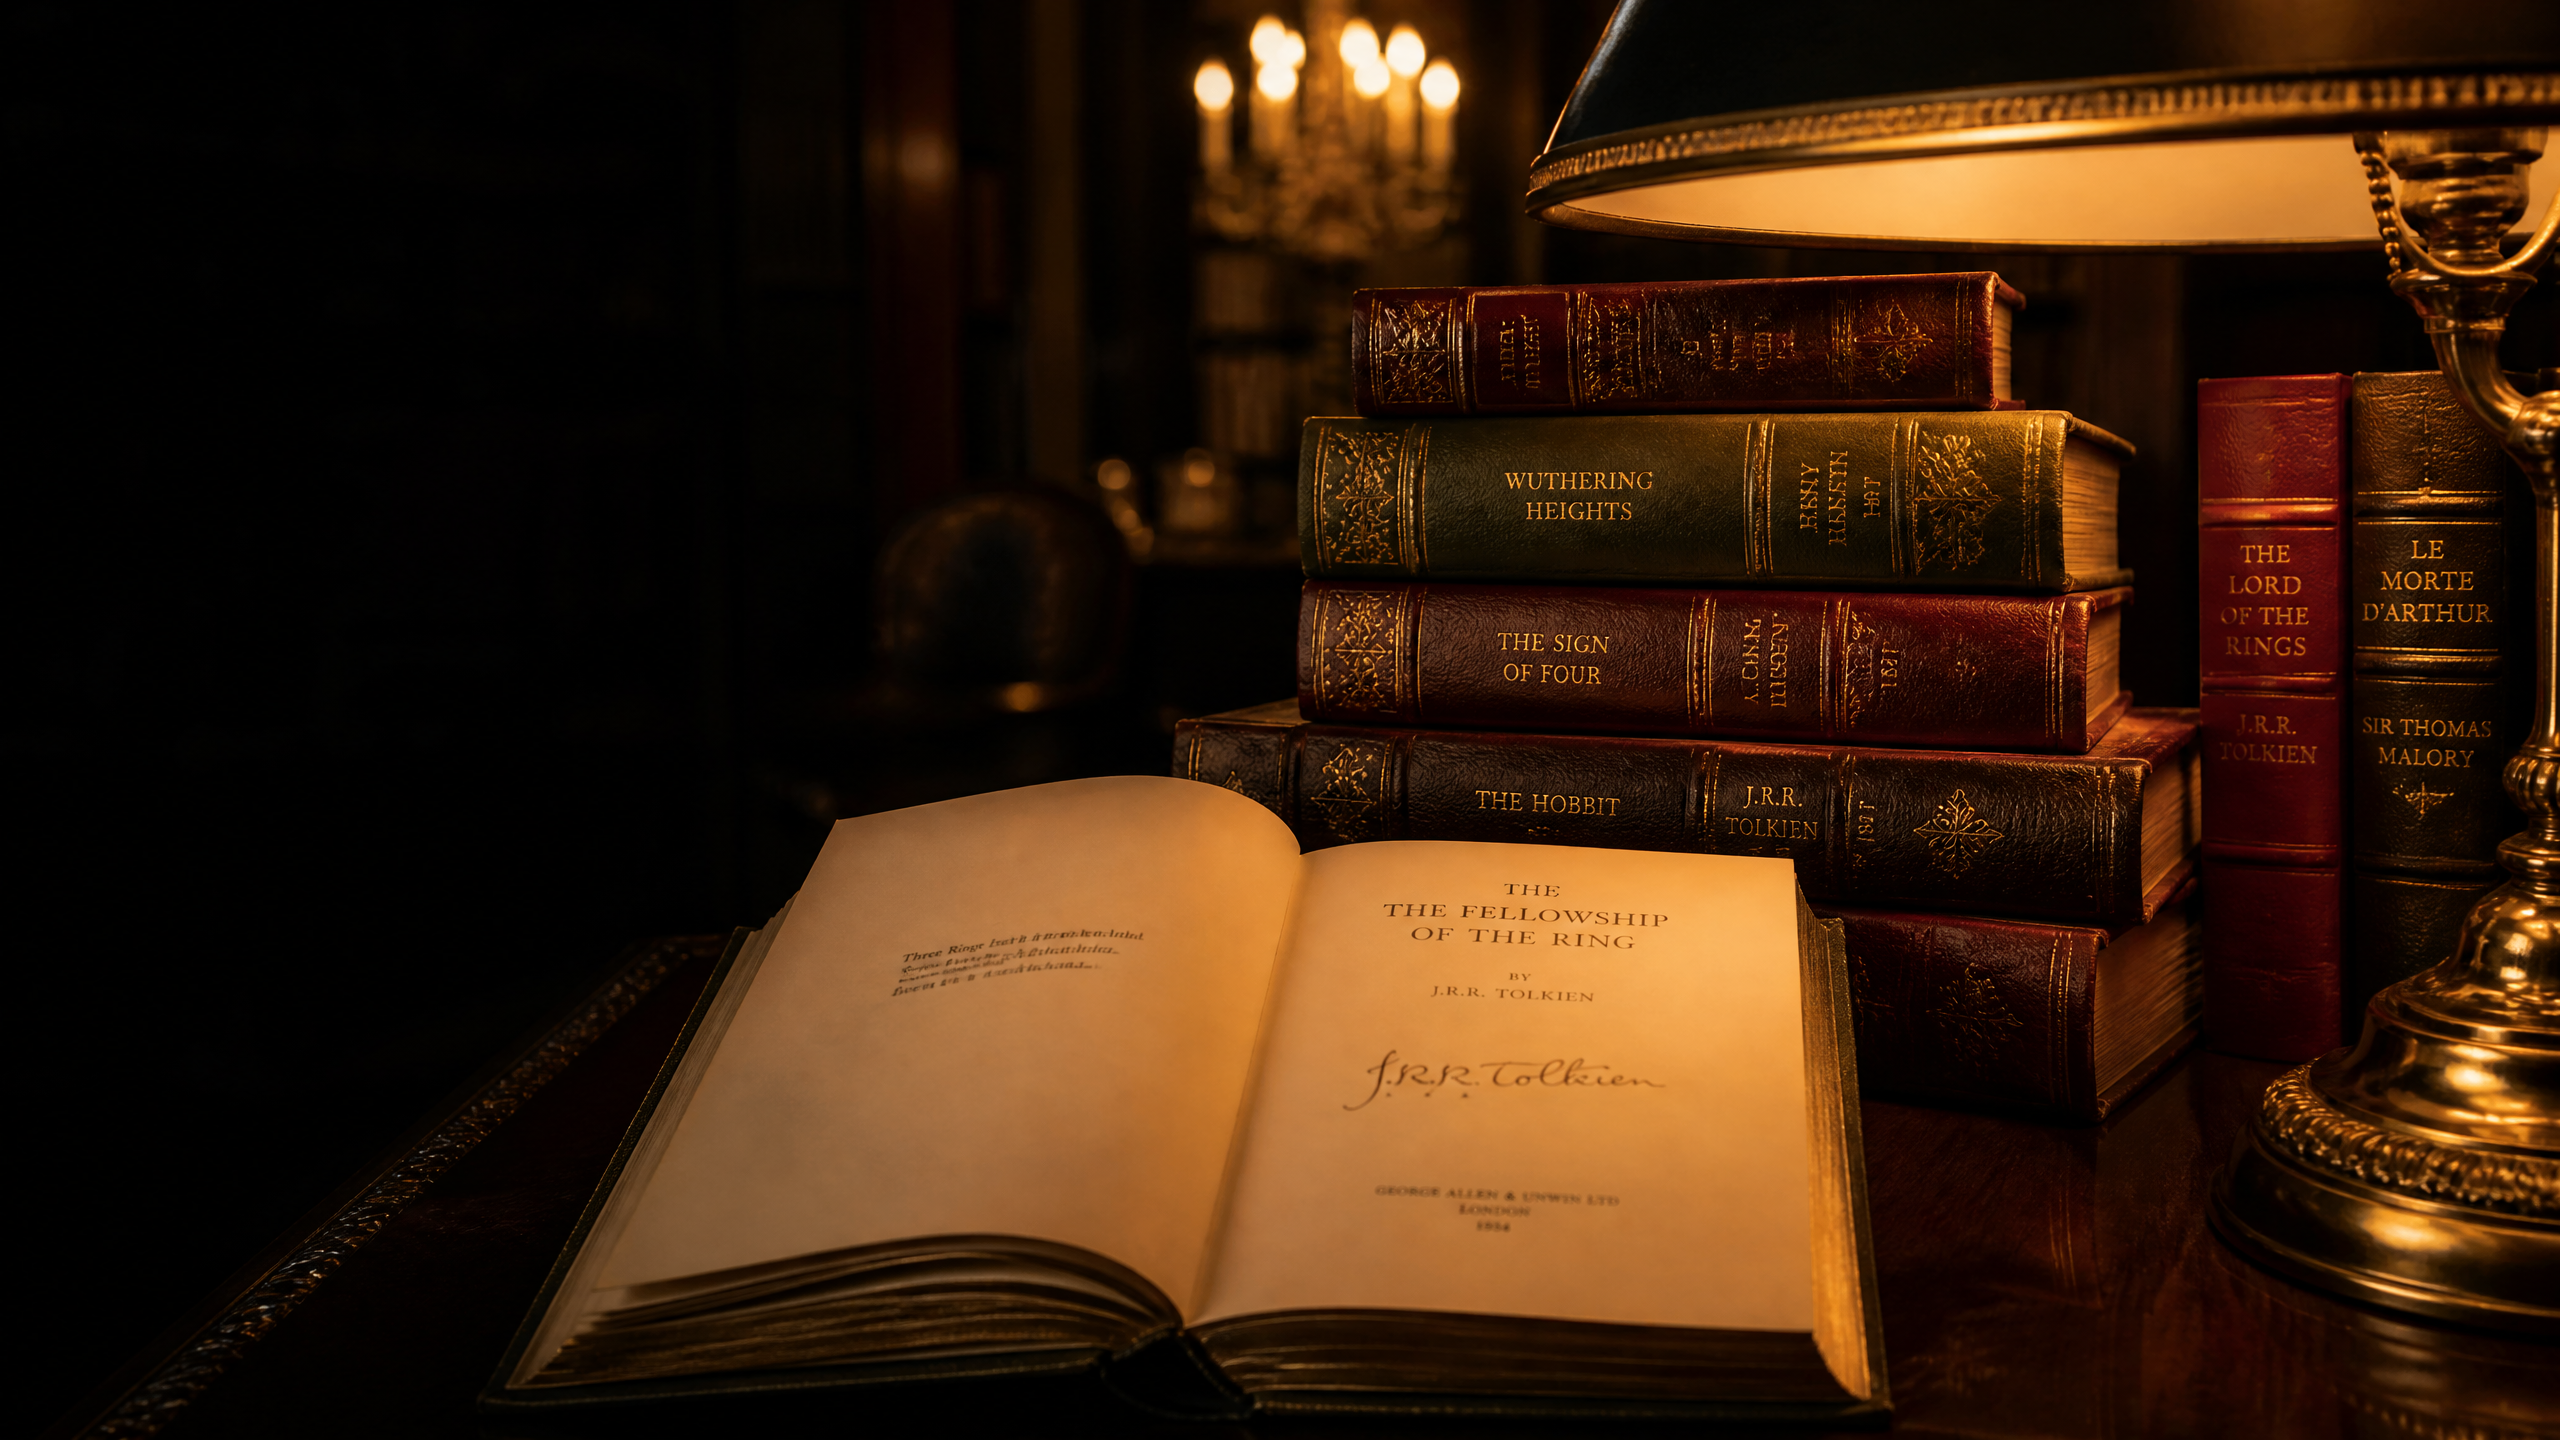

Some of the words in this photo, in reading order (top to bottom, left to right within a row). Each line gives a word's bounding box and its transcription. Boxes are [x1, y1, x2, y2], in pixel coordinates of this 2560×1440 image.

[1505, 472, 1653, 490] WUTHERING
[1526, 502, 1632, 521] HEIGHTS
[2240, 544, 2291, 563] THE
[2411, 540, 2445, 559] LE
[2229, 576, 2302, 595] LORD
[2380, 571, 2474, 591] MORTE
[2220, 606, 2252, 625] OF
[2259, 607, 2310, 625] THE
[2361, 603, 2493, 623] D'ARTHUR
[1498, 632, 1545, 652] THE
[1554, 634, 1610, 654] SIGN
[2225, 636, 2307, 656] RINGS
[1503, 663, 1533, 682] OF
[1541, 665, 1602, 685] FOUR
[2236, 714, 2297, 735] J.R.R.
[2362, 717, 2395, 735] SIR
[2400, 718, 2492, 737] THOMAS
[2219, 743, 2318, 764] TOLKIEN
[2378, 747, 2475, 768] MALORY
[1475, 790, 1523, 812] THE
[1532, 794, 1621, 817] HOBBIT
[1743, 785, 1803, 809] J.R.R.
[1725, 816, 1818, 840] TOLKIEN
[1504, 883, 1561, 898] THE
[1383, 903, 1447, 918] THE
[1460, 905, 1669, 928] FELLOWSHIP
[1411, 927, 1454, 942] OF
[1468, 928, 1537, 945] THE
[1552, 932, 1635, 949] RING
[1509, 972, 1532, 982] BY
[1431, 985, 1486, 998] J.R.R.
[1495, 988, 1594, 1002] TOLKIEN
